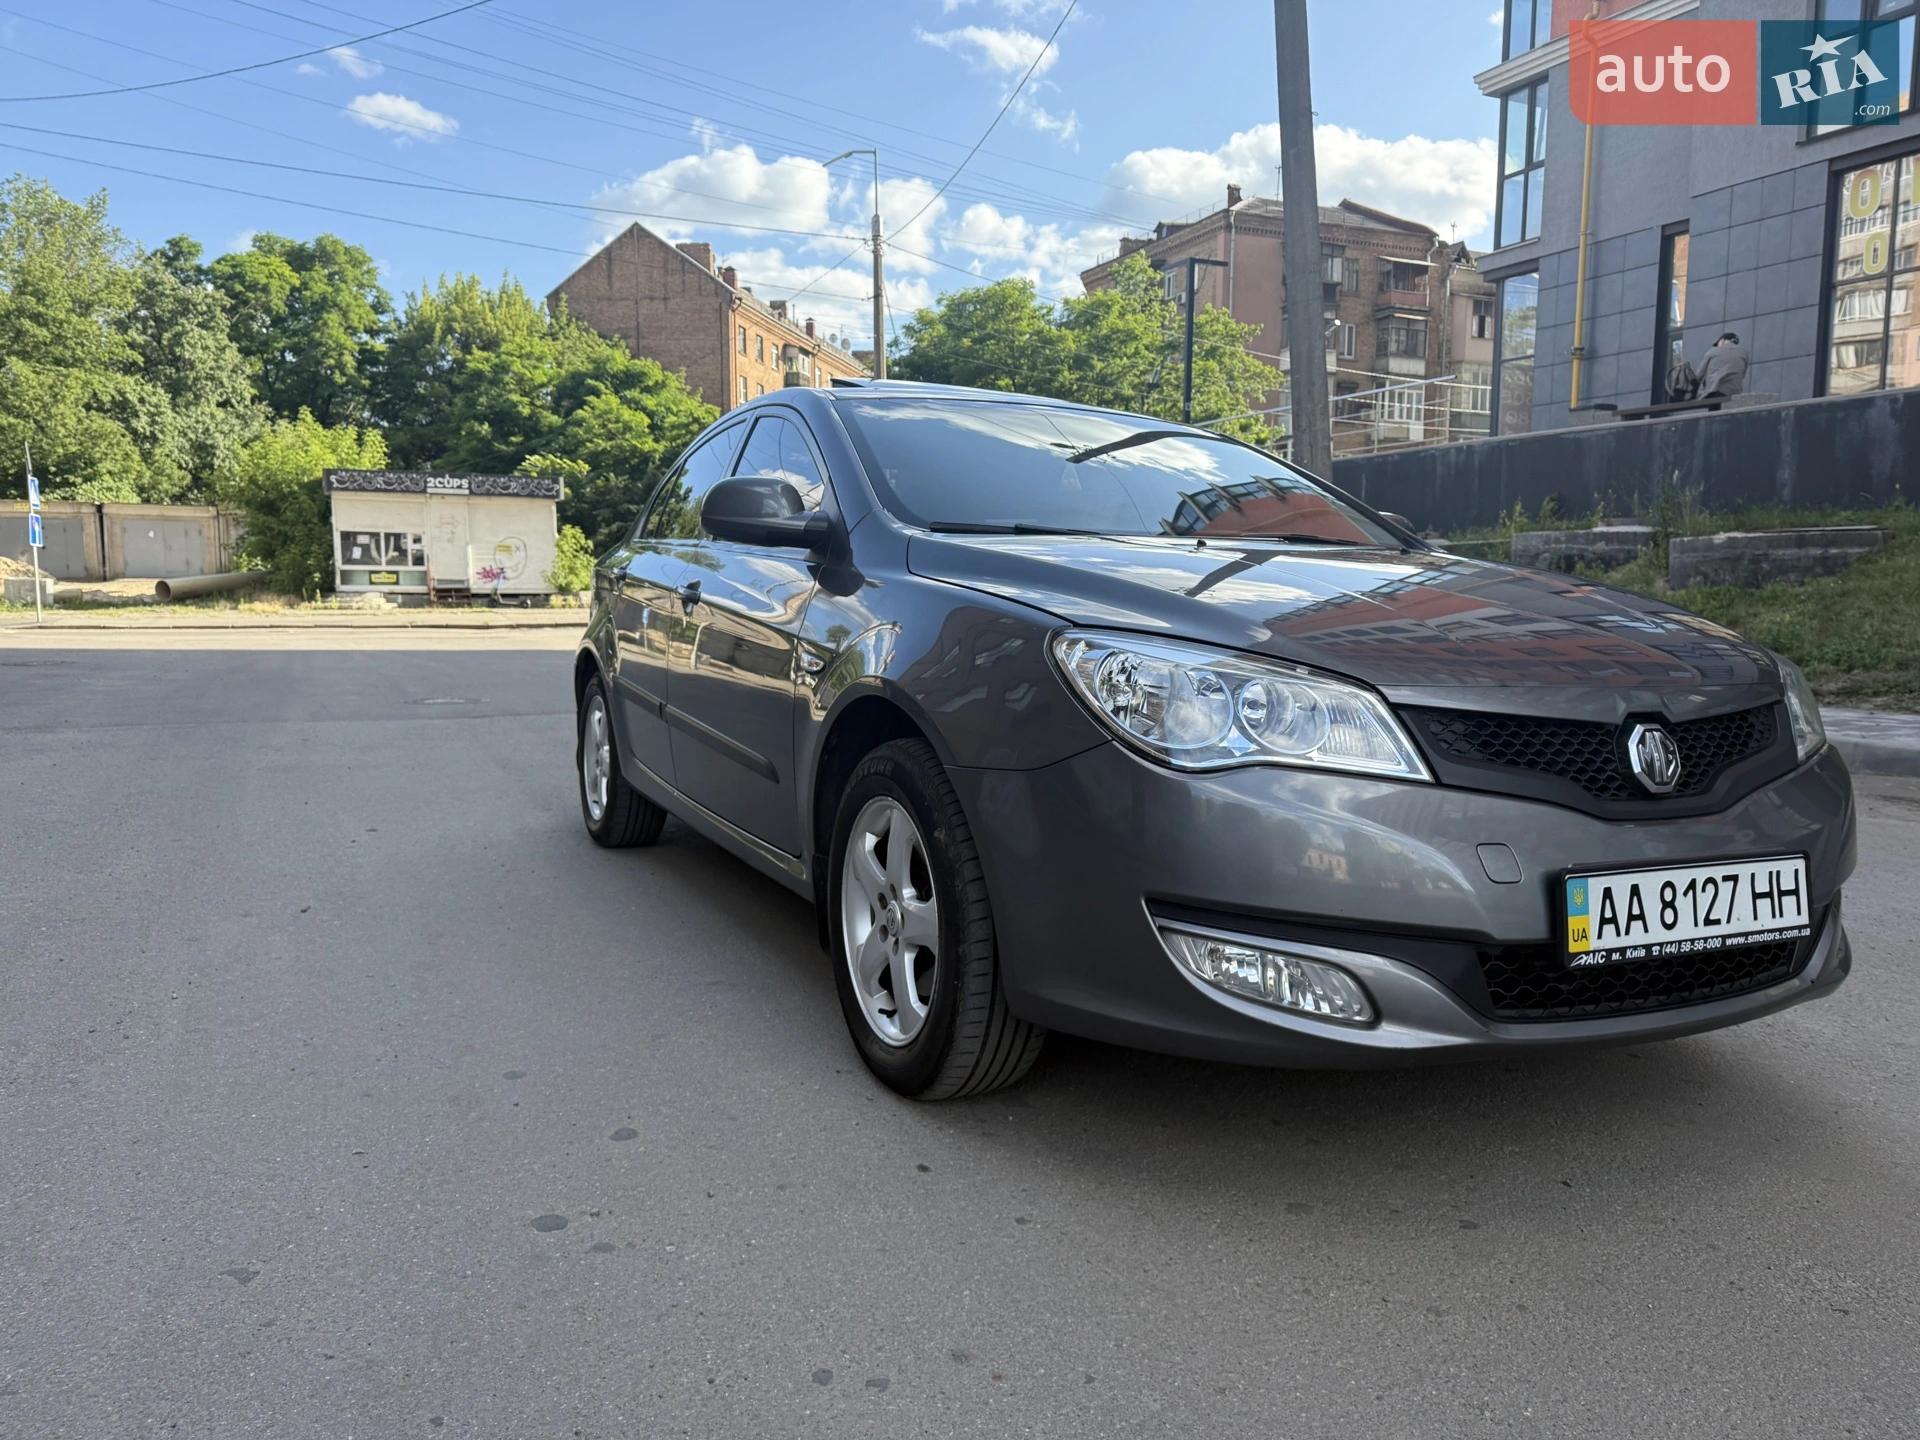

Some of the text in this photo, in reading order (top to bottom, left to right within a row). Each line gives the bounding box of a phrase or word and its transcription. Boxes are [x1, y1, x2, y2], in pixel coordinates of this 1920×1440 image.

[426, 475, 470, 489] 2CUPS
[1596, 868, 1802, 940] AA 8127 HH
[1572, 928, 1589, 943] UA
[1625, 948, 1646, 960] Київ
[1662, 944, 1679, 956] (44)
[1680, 937, 1722, 952] 58-58-000
[1725, 927, 1811, 946] www.smotors.com.ua
